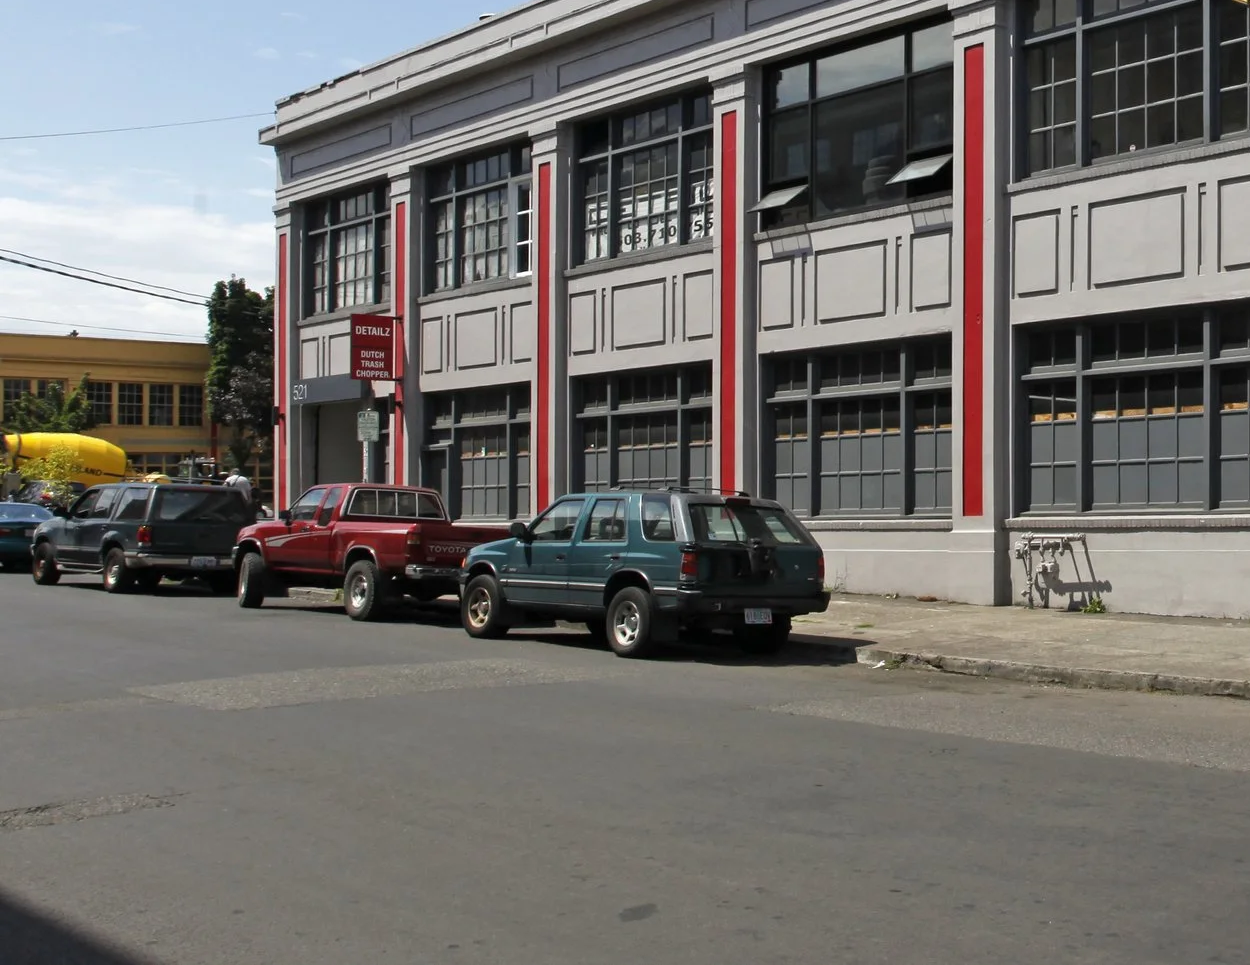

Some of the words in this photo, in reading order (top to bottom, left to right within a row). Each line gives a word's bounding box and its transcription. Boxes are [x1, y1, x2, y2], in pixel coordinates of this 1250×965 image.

[355, 325, 391, 336] DETAILZ
[360, 350, 385, 359] DUTCH
[360, 360, 385, 368] TRASH
[293, 384, 308, 400] 521
[428, 545, 467, 553] TOYOTA
